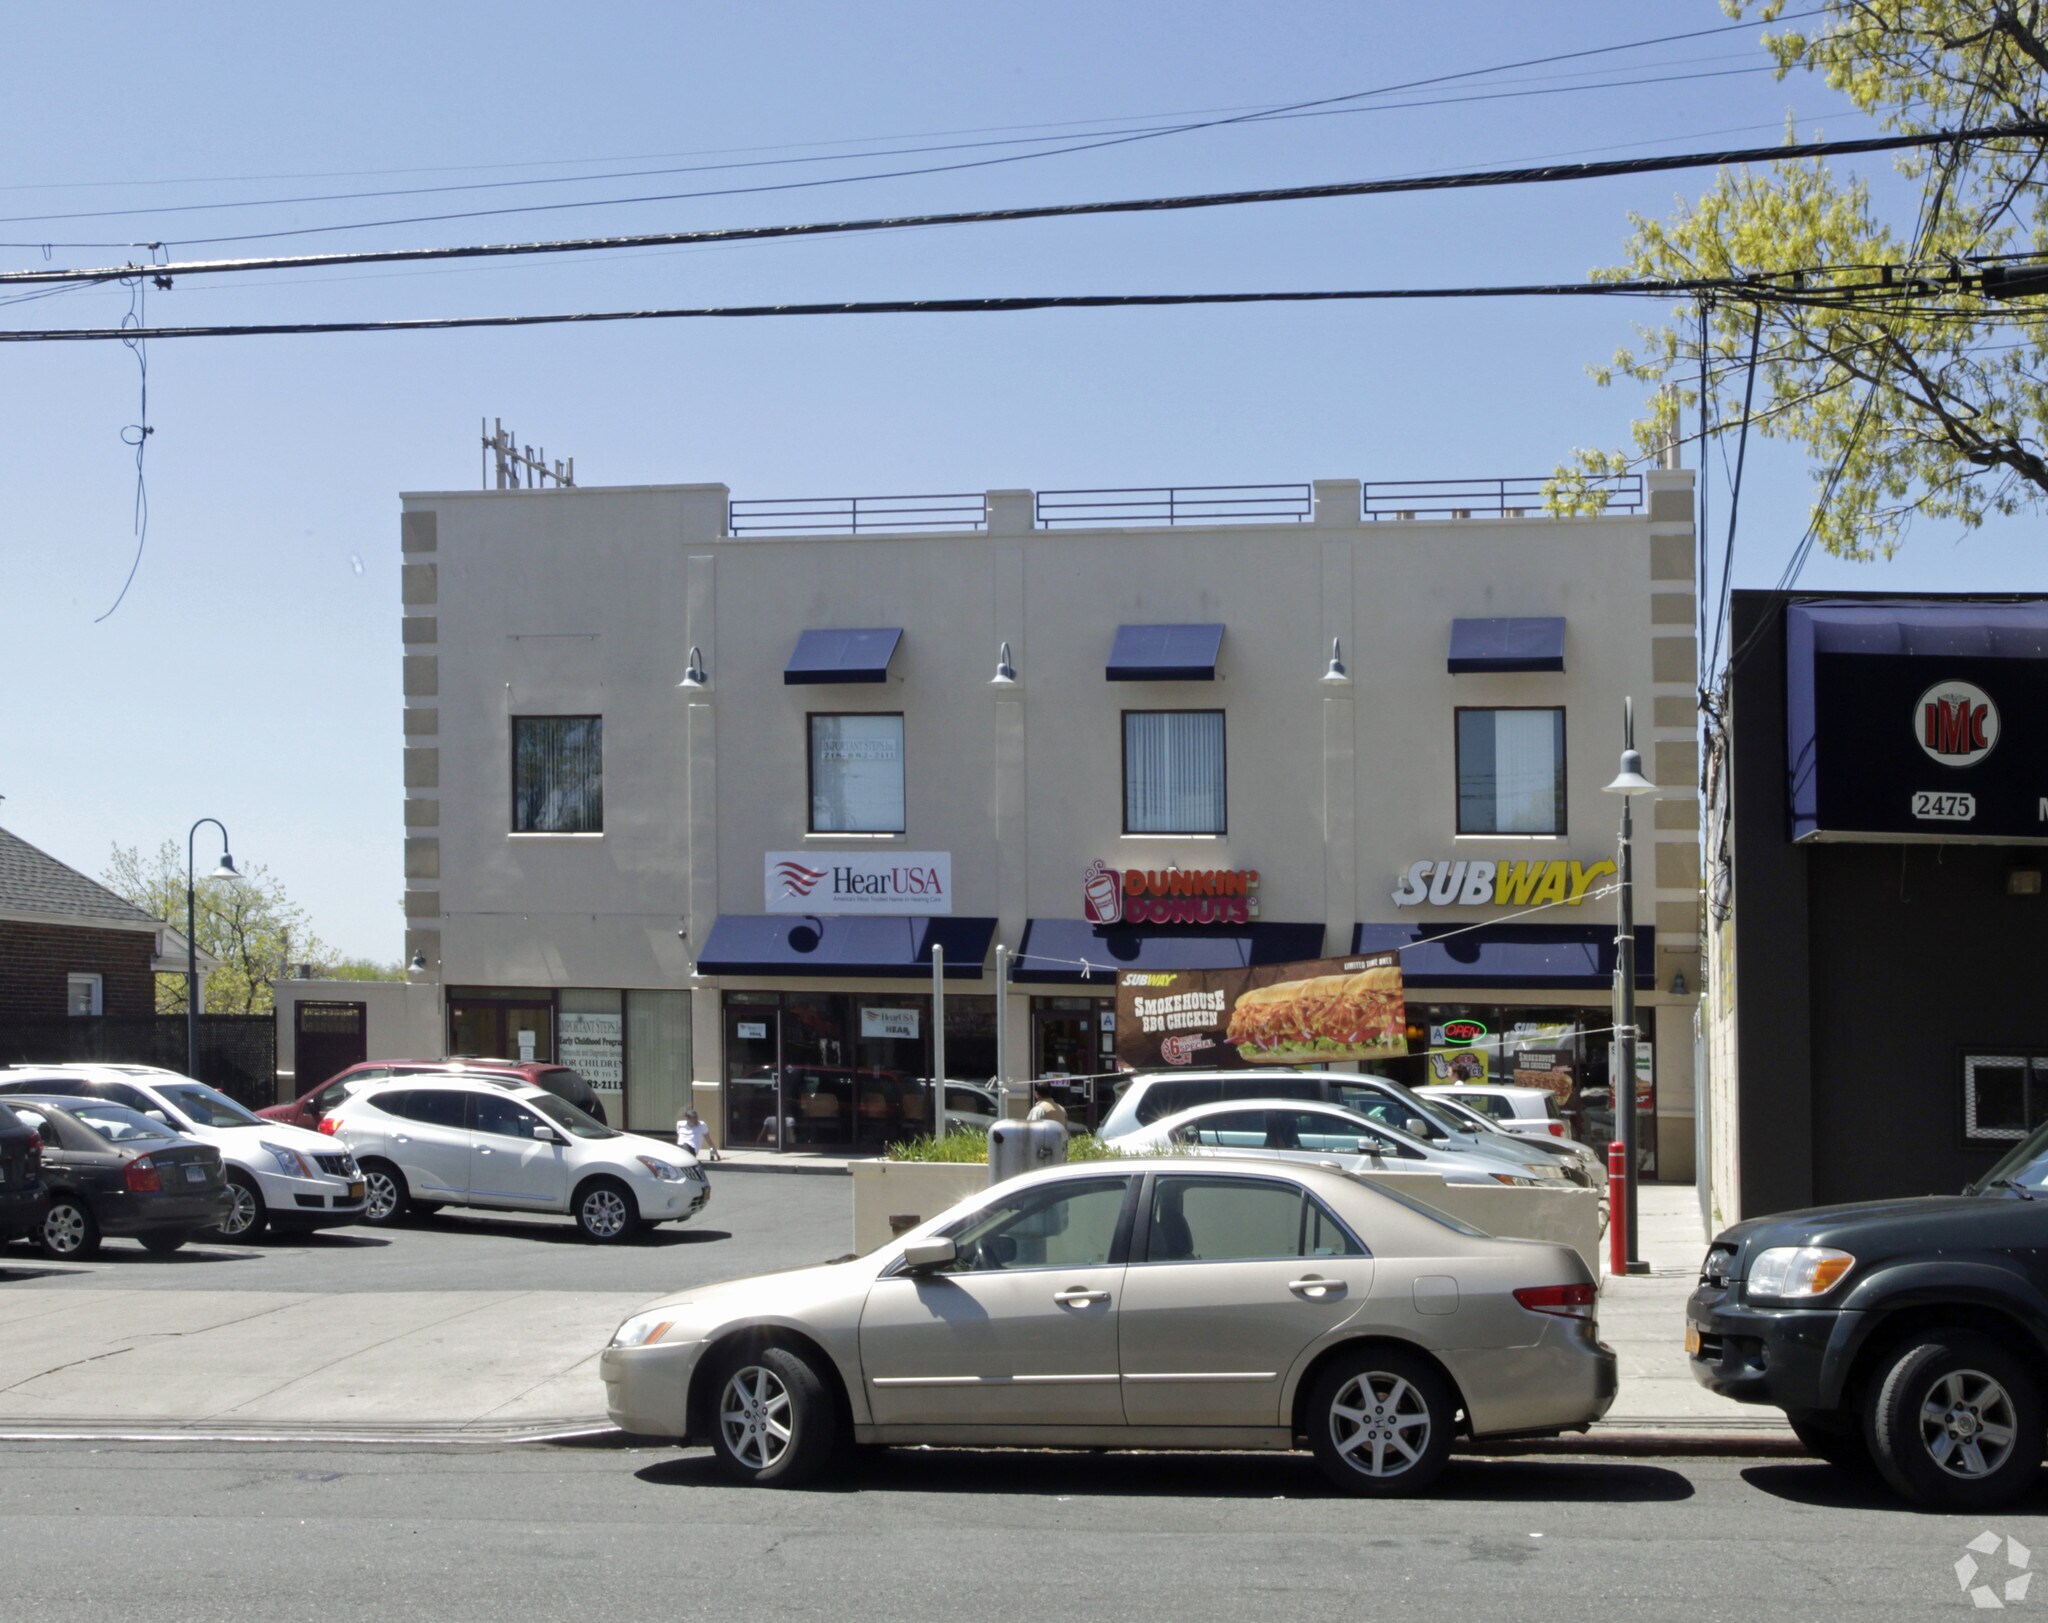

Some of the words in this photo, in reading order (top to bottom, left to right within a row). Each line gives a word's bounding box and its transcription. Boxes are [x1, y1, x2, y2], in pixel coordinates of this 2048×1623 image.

[1925, 697, 1988, 755] IMC
[1917, 795, 1970, 817] 2475
[833, 867, 943, 894] HearUSA
[1125, 869, 1258, 896] DUNKIN'
[1391, 856, 1617, 909] SUBWAY
[1125, 897, 1249, 924] DONUTS
[1122, 974, 1177, 986] SUBWAY
[1103, 1015, 1113, 1026] A
[1142, 1015, 1165, 1032] BBQ
[1166, 1010, 1218, 1030] CHICKEN
[1445, 1024, 1480, 1039] OPEN
[1433, 1029, 1443, 1040] A
